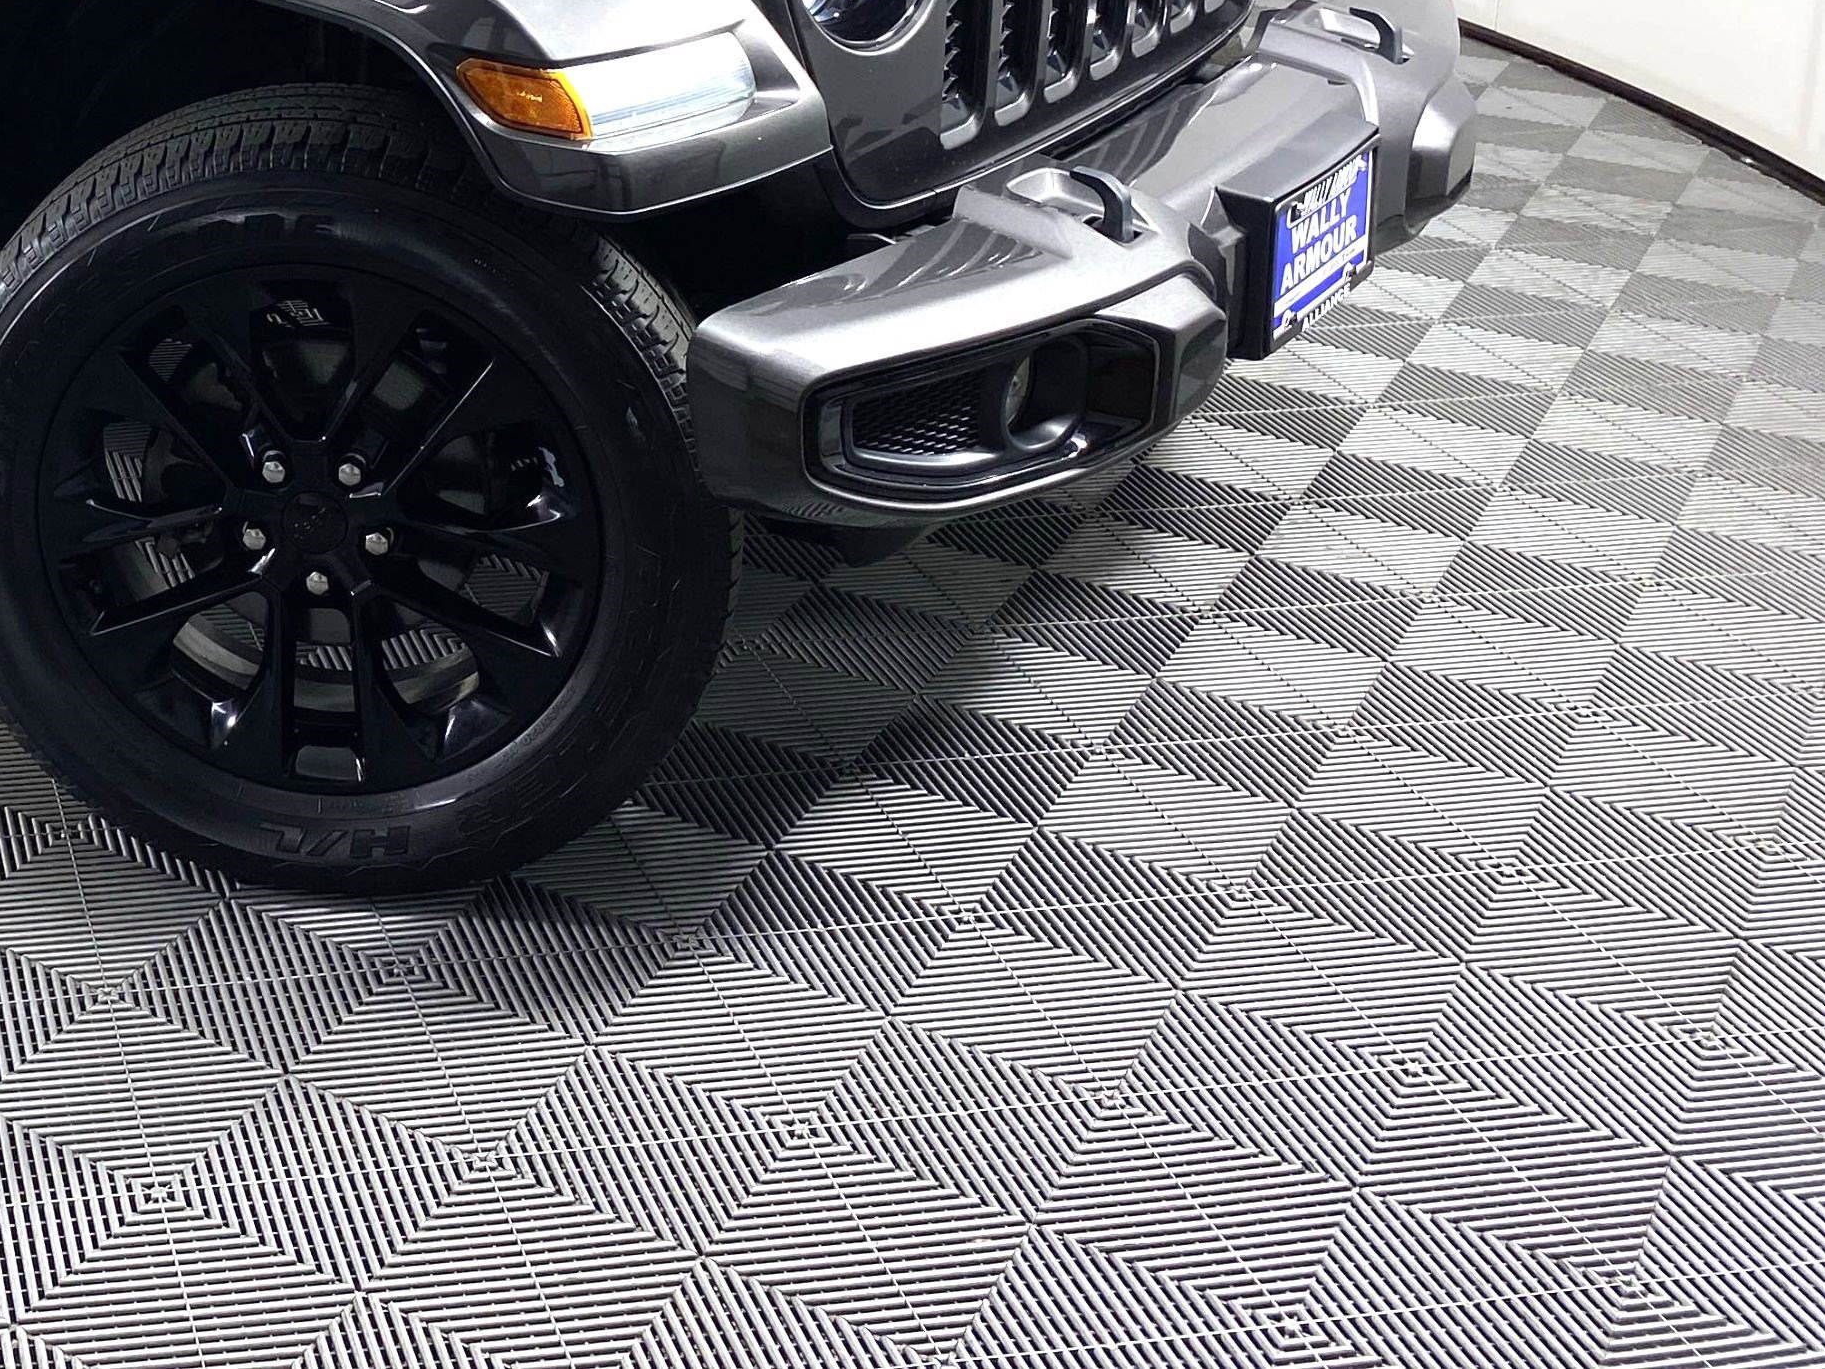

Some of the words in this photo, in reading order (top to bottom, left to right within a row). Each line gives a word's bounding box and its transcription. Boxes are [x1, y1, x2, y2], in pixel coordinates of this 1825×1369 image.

[1291, 187, 1352, 254] WALLY
[1280, 214, 1358, 296] ARMOUR
[1302, 283, 1351, 332] ALLIANCE
